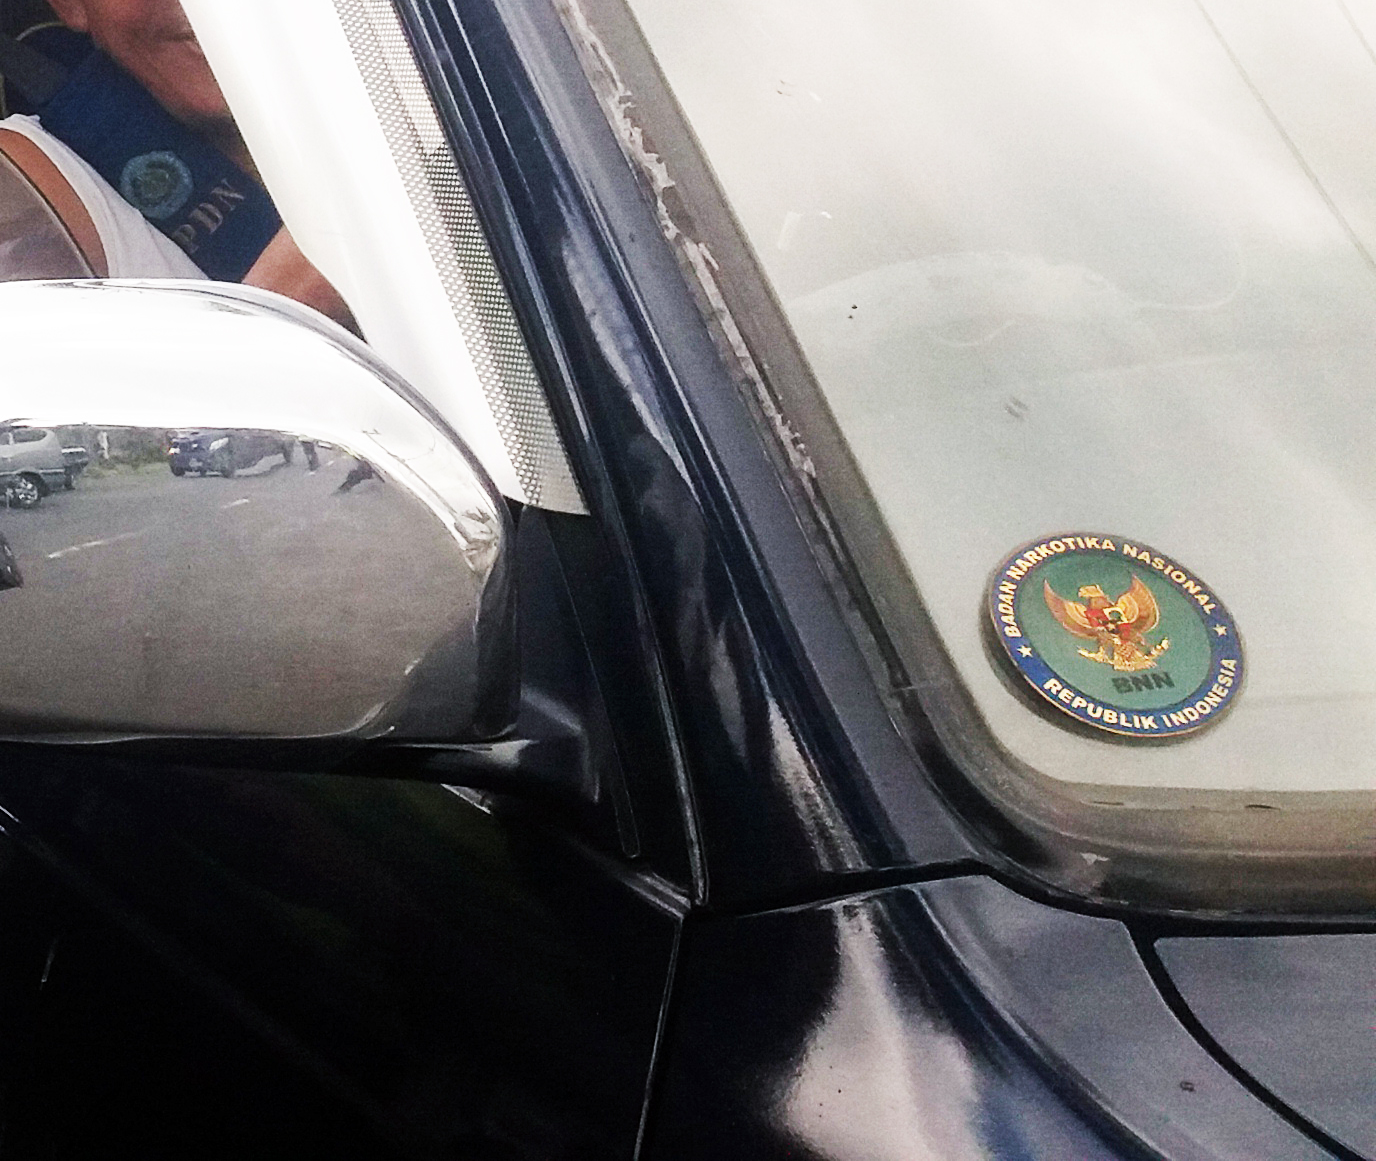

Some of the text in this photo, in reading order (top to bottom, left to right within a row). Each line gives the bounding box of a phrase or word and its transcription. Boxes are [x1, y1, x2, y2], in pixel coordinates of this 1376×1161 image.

[998, 536, 1218, 638] BADAN NARKOTIKA NASIONAL
[1042, 657, 1238, 730] REPUBLIK INDONESIA
[1111, 671, 1176, 694] BNN
